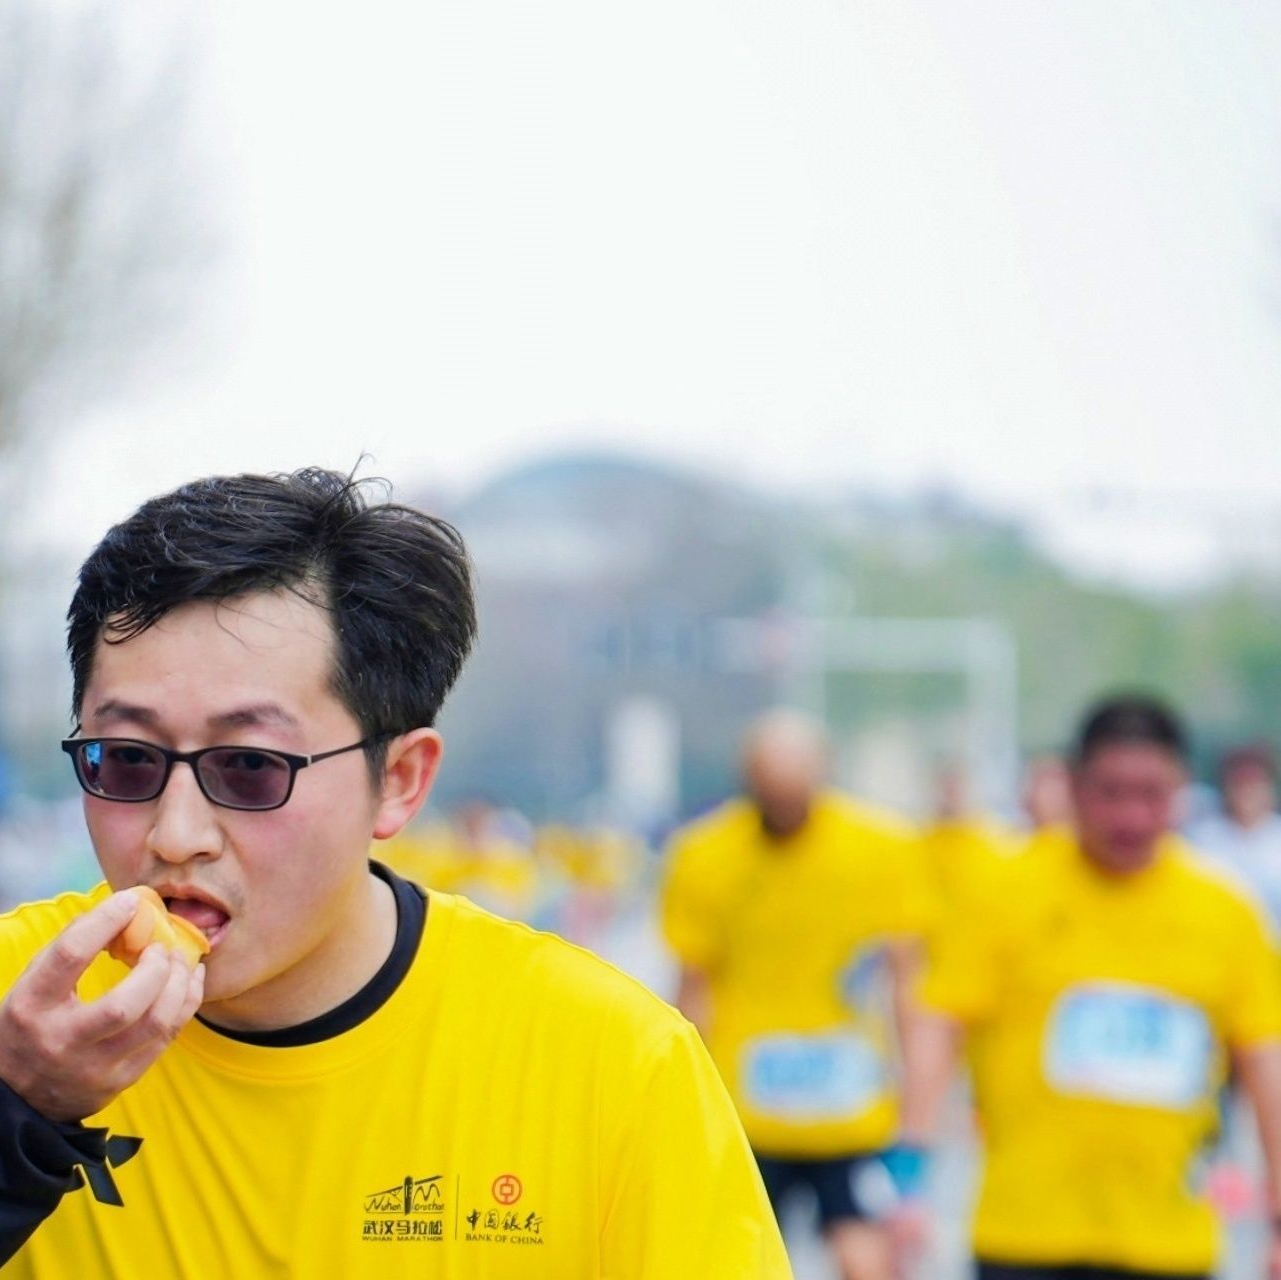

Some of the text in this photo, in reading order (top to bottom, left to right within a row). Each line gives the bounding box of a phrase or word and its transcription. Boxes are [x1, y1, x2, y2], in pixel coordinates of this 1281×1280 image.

[363, 1220, 443, 1236] 武汉马拉松
[466, 1208, 543, 1234] 中国银行
[465, 1233, 544, 1245] BANK OF CHINA
